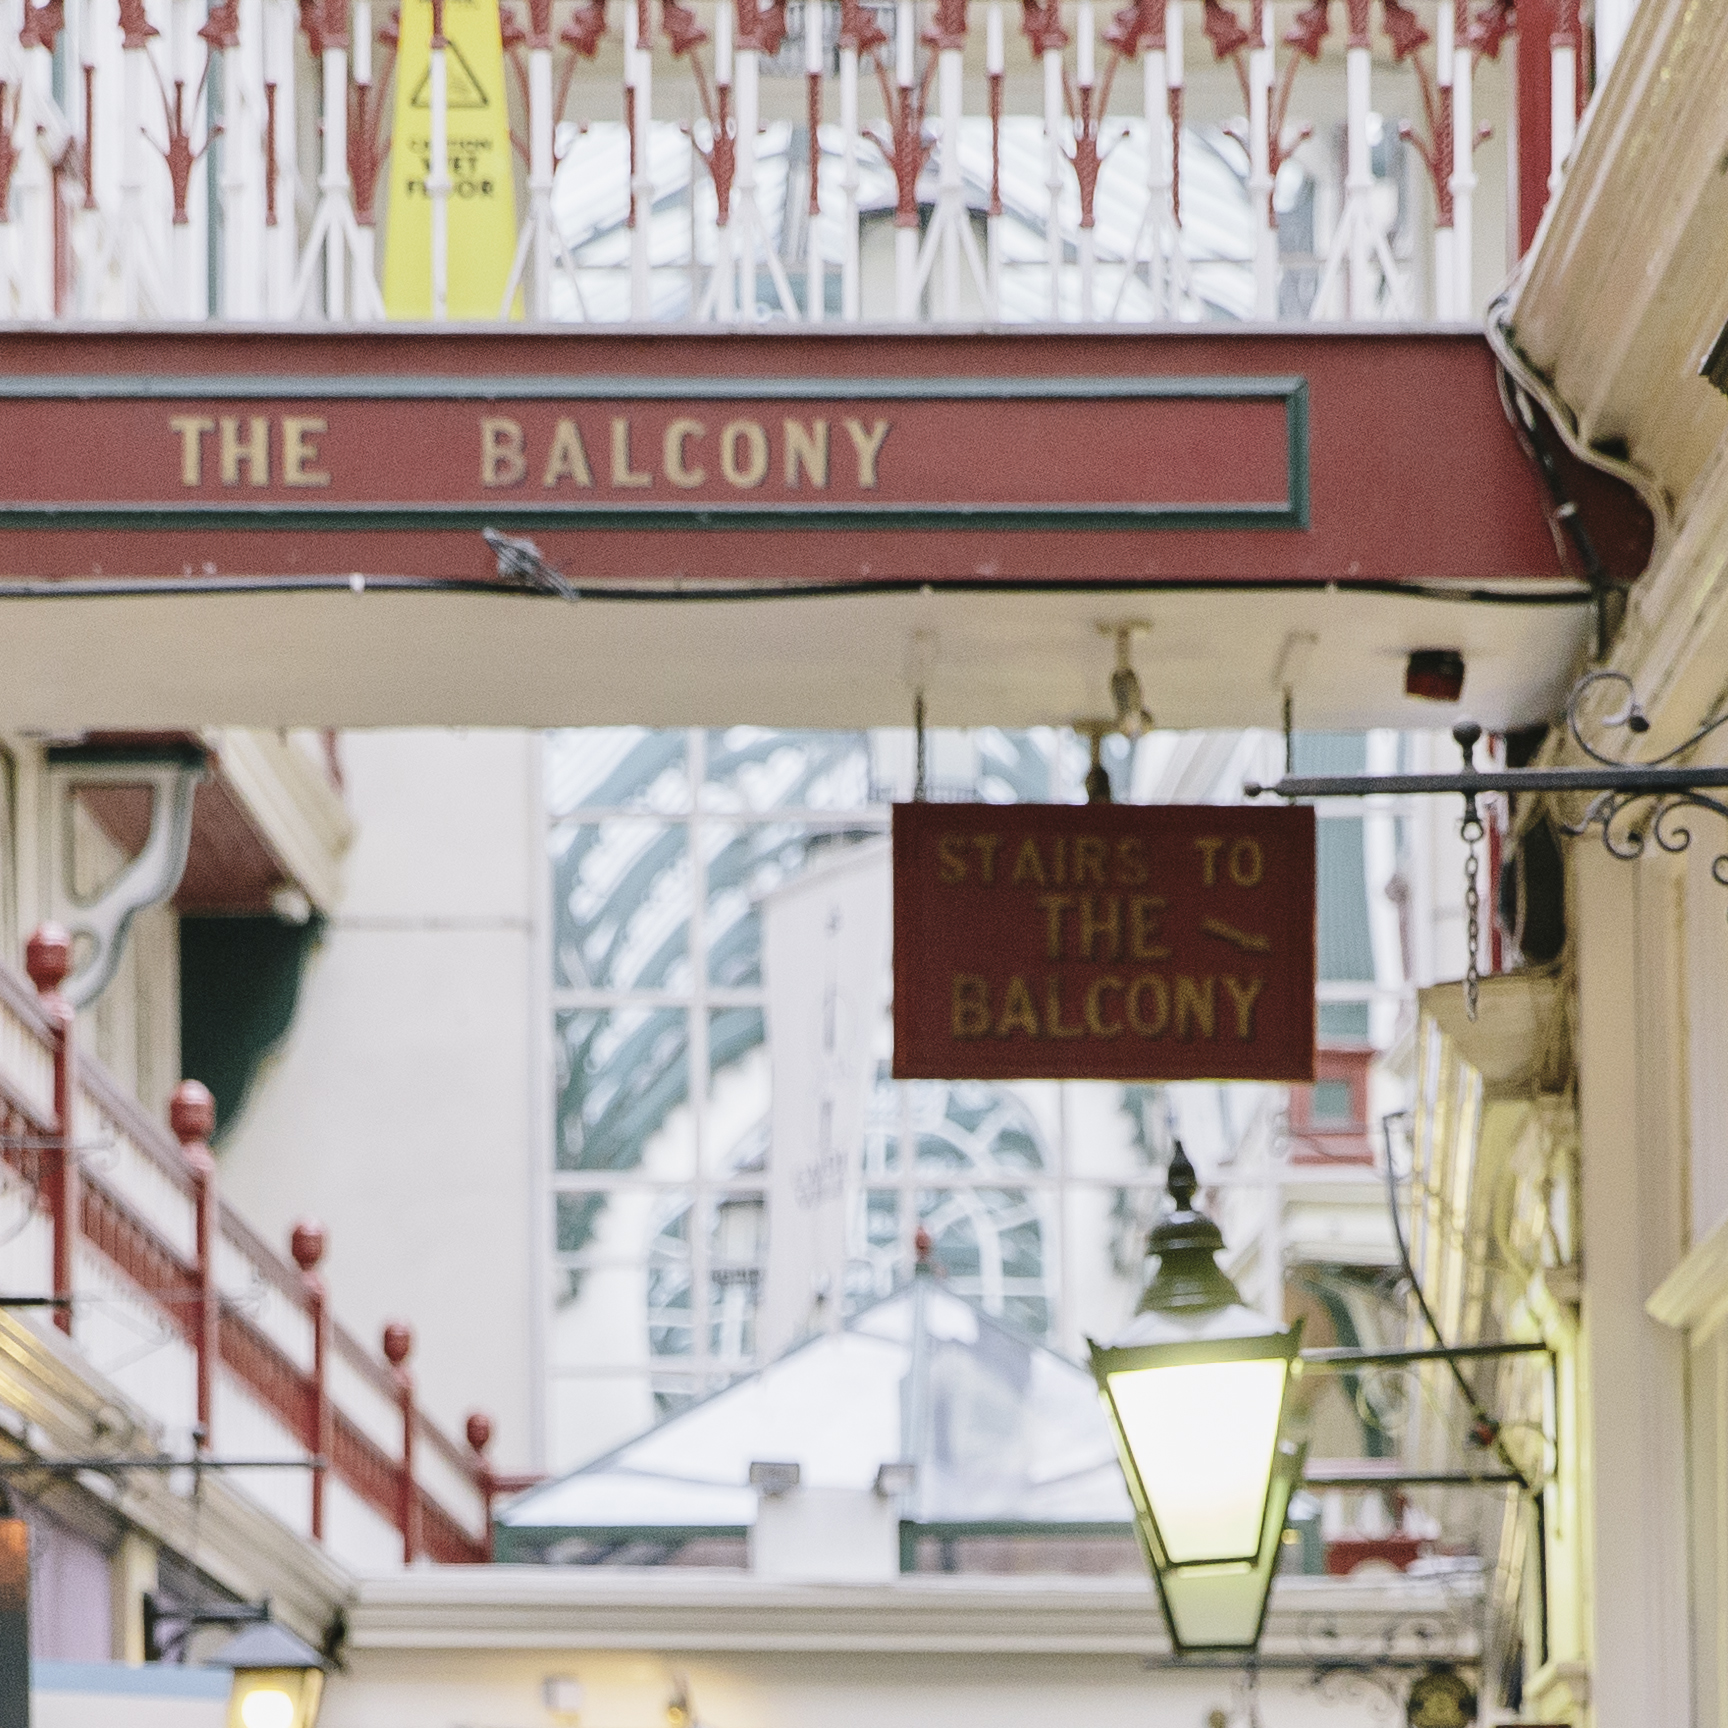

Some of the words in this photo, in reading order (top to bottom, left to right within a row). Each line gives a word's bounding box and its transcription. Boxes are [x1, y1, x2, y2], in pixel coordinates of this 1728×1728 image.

[169, 415, 330, 487] THE
[480, 417, 890, 490] BALCONY
[935, 832, 1150, 887] STAIRS
[1193, 836, 1266, 889] TO
[1037, 893, 1172, 961] THE
[949, 972, 1263, 1040] BALCONY
